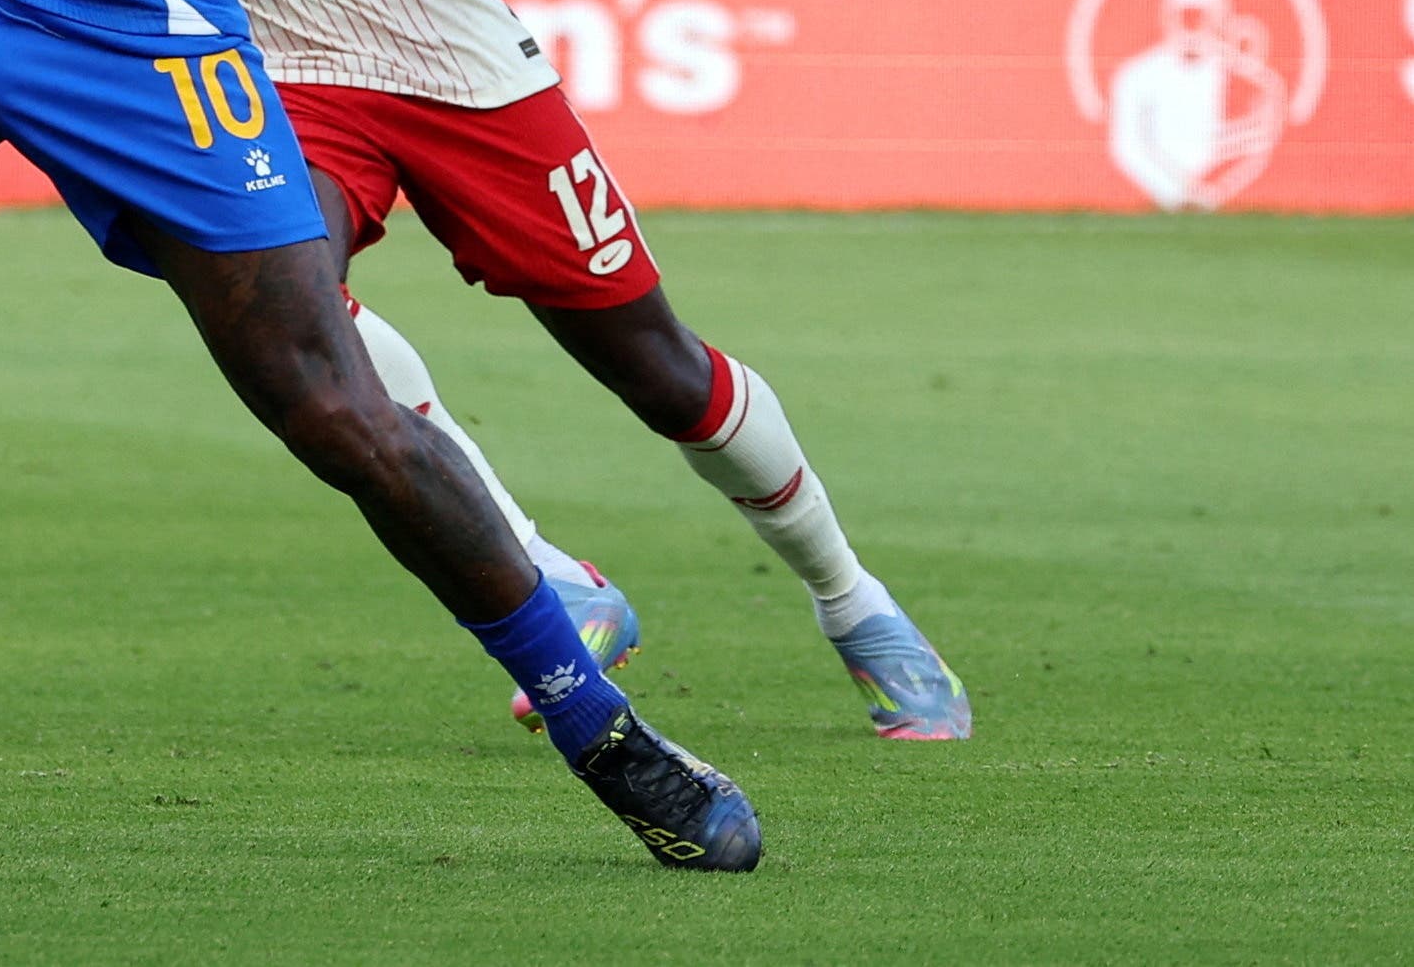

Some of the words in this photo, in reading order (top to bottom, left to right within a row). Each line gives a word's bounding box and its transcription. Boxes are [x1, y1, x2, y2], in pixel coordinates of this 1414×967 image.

[153, 48, 266, 150] 10
[245, 174, 287, 192] KELME
[548, 147, 627, 252] 12
